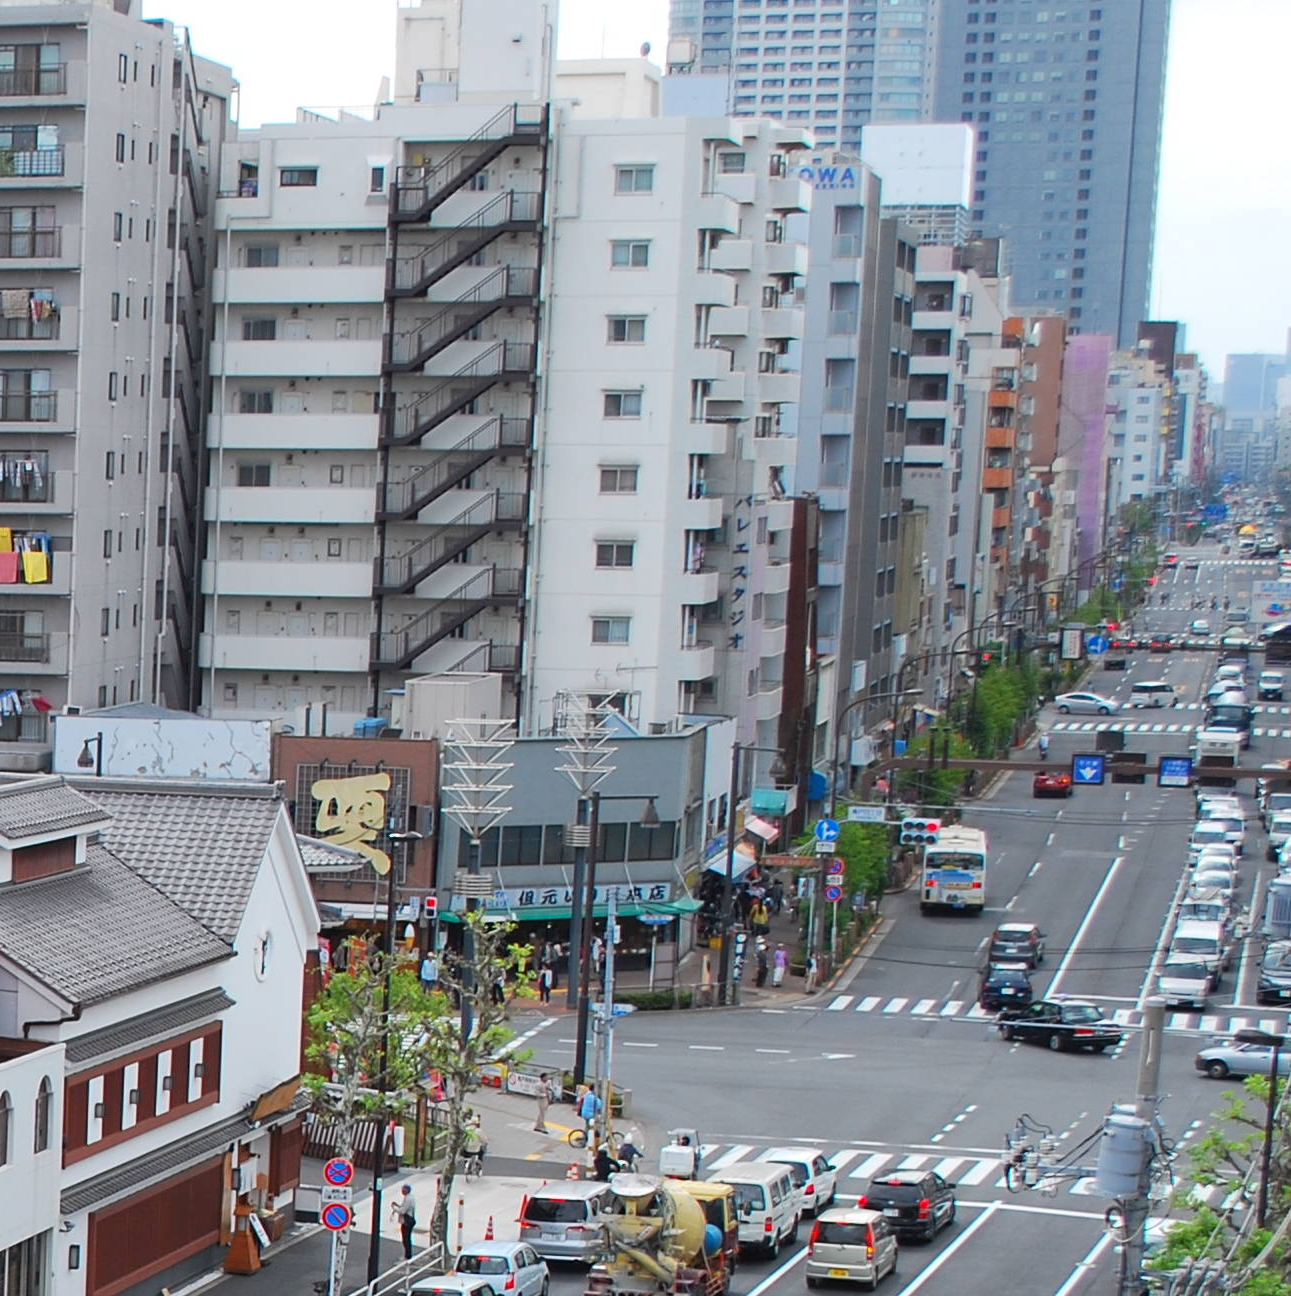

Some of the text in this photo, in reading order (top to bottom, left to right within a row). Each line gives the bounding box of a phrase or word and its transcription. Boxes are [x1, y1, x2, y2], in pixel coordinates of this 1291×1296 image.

[728, 494, 754, 649] バレエスタジオ
